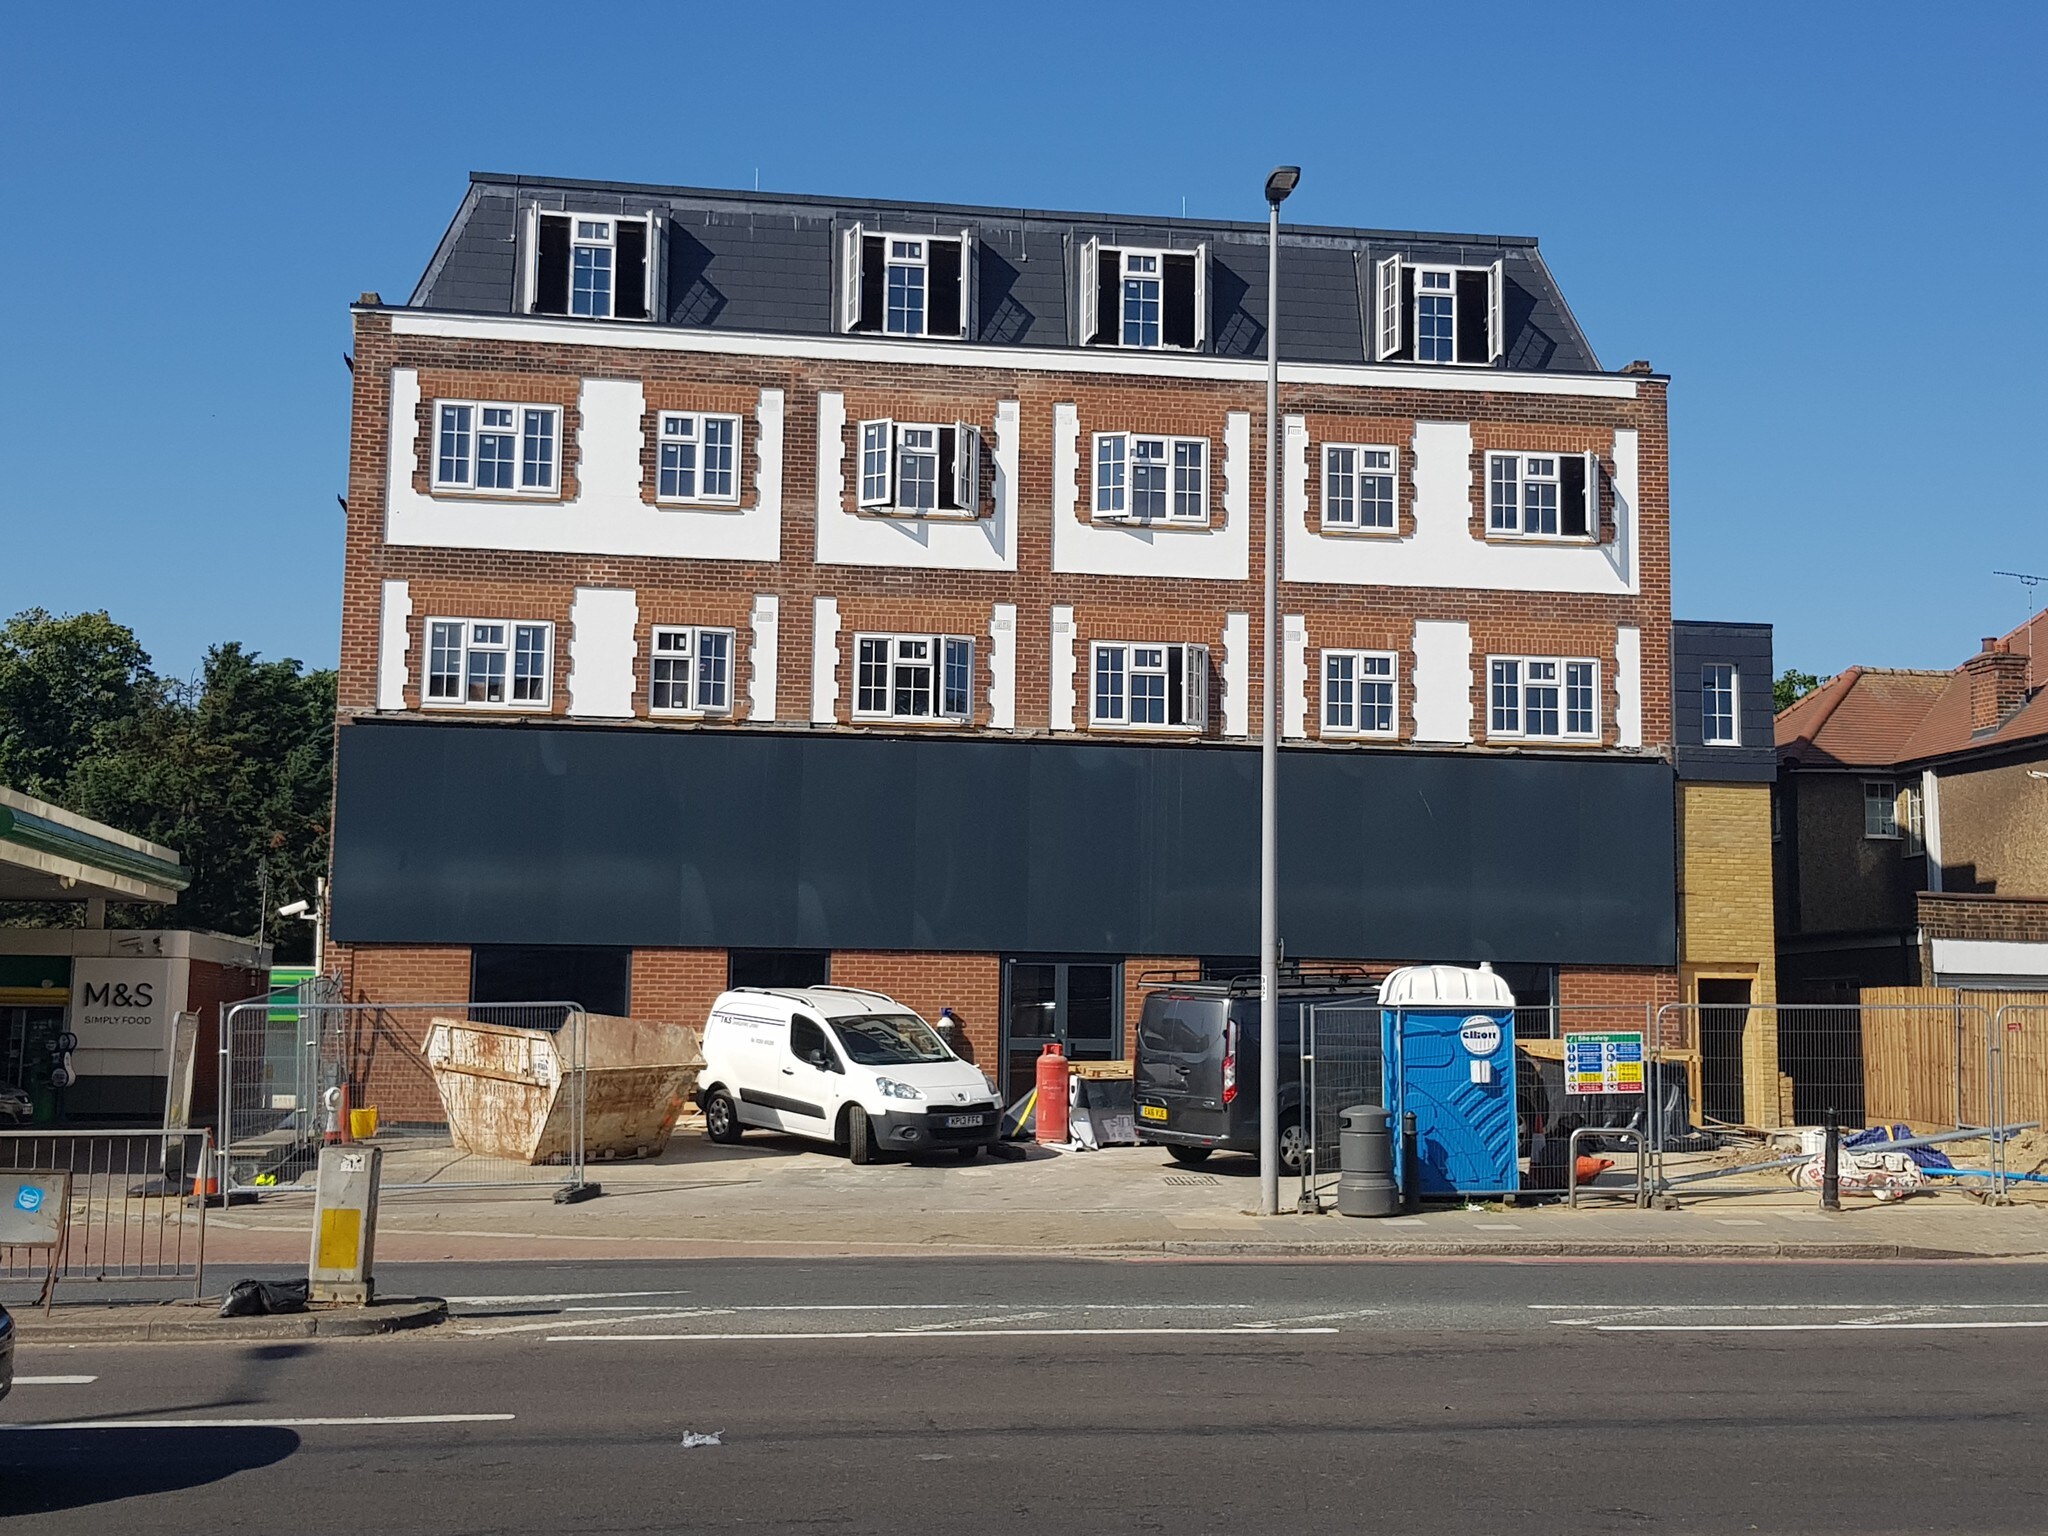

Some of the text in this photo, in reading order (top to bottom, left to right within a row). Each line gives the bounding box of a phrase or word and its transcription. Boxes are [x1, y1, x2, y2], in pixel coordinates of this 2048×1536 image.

[84, 982, 153, 1008] M&S
[84, 1015, 152, 1025] SIMPLY FOOD
